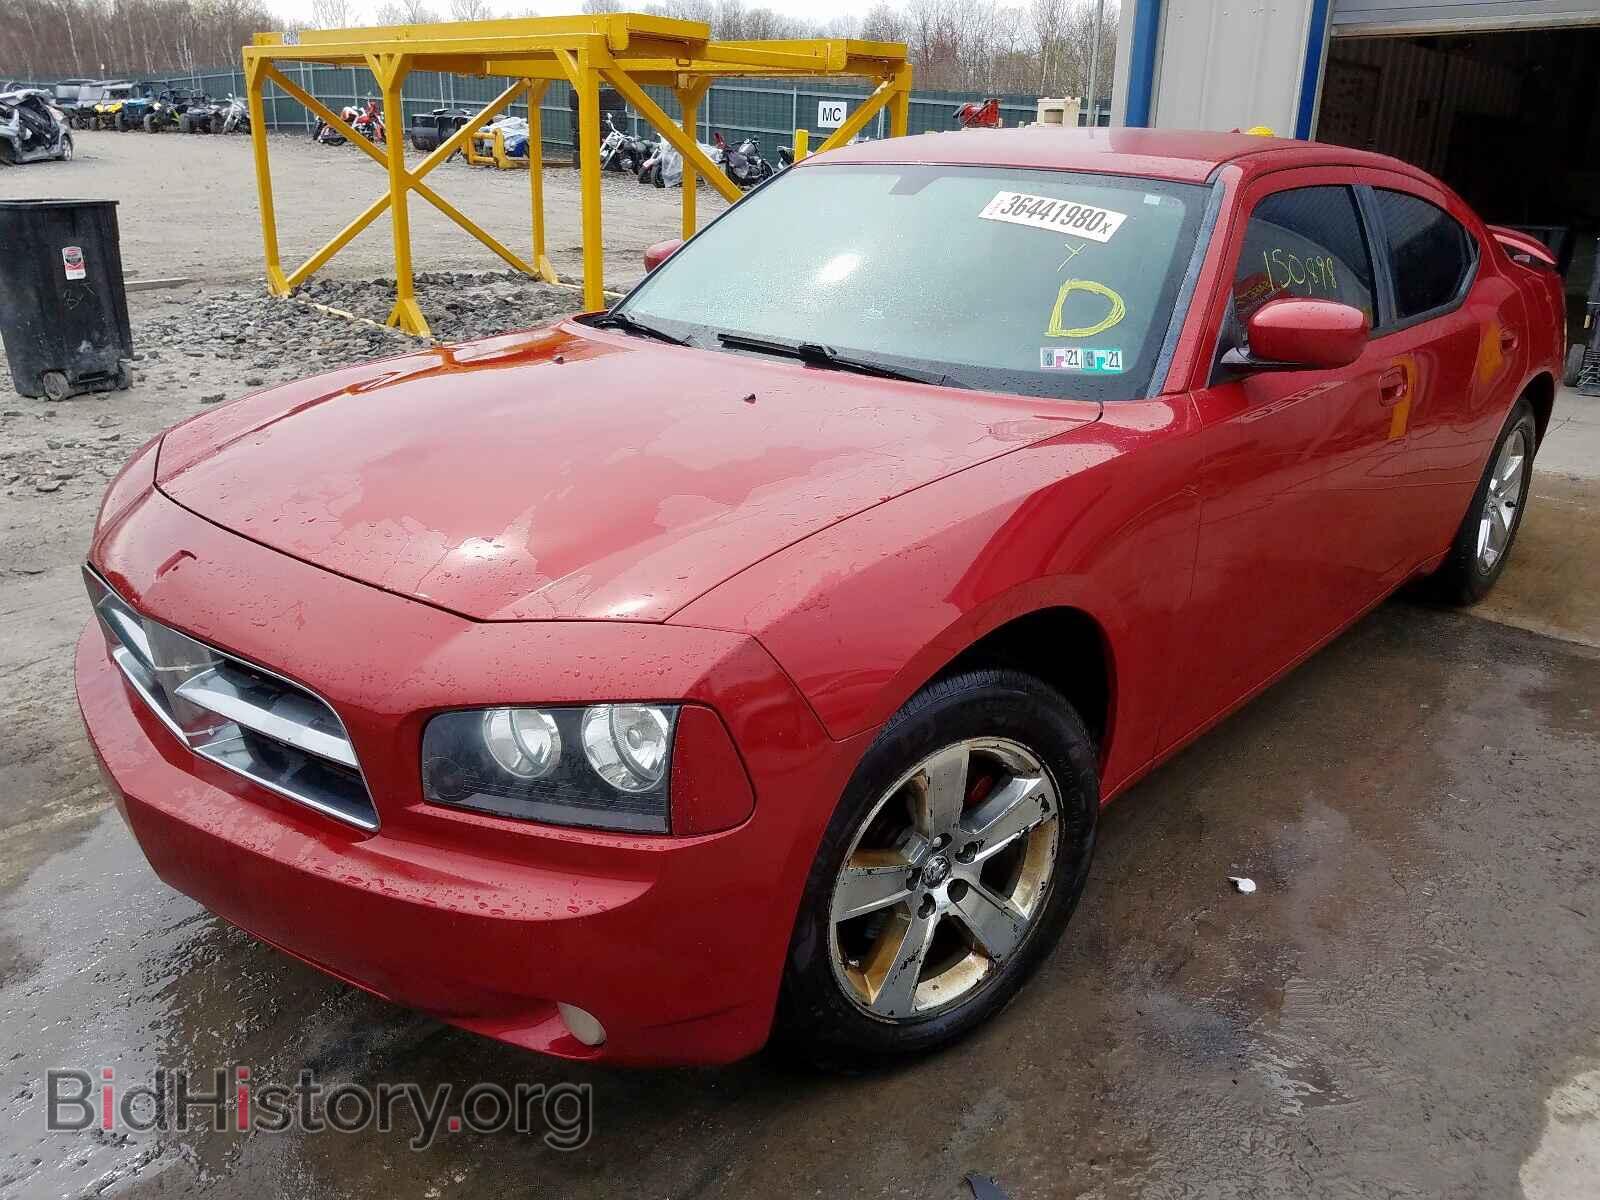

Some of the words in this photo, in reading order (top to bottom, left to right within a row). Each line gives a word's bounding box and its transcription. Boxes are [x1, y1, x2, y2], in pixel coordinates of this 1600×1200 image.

[822, 107, 842, 122] MC
[1000, 195, 1106, 232] 36441980
[1043, 278, 1126, 338] D
